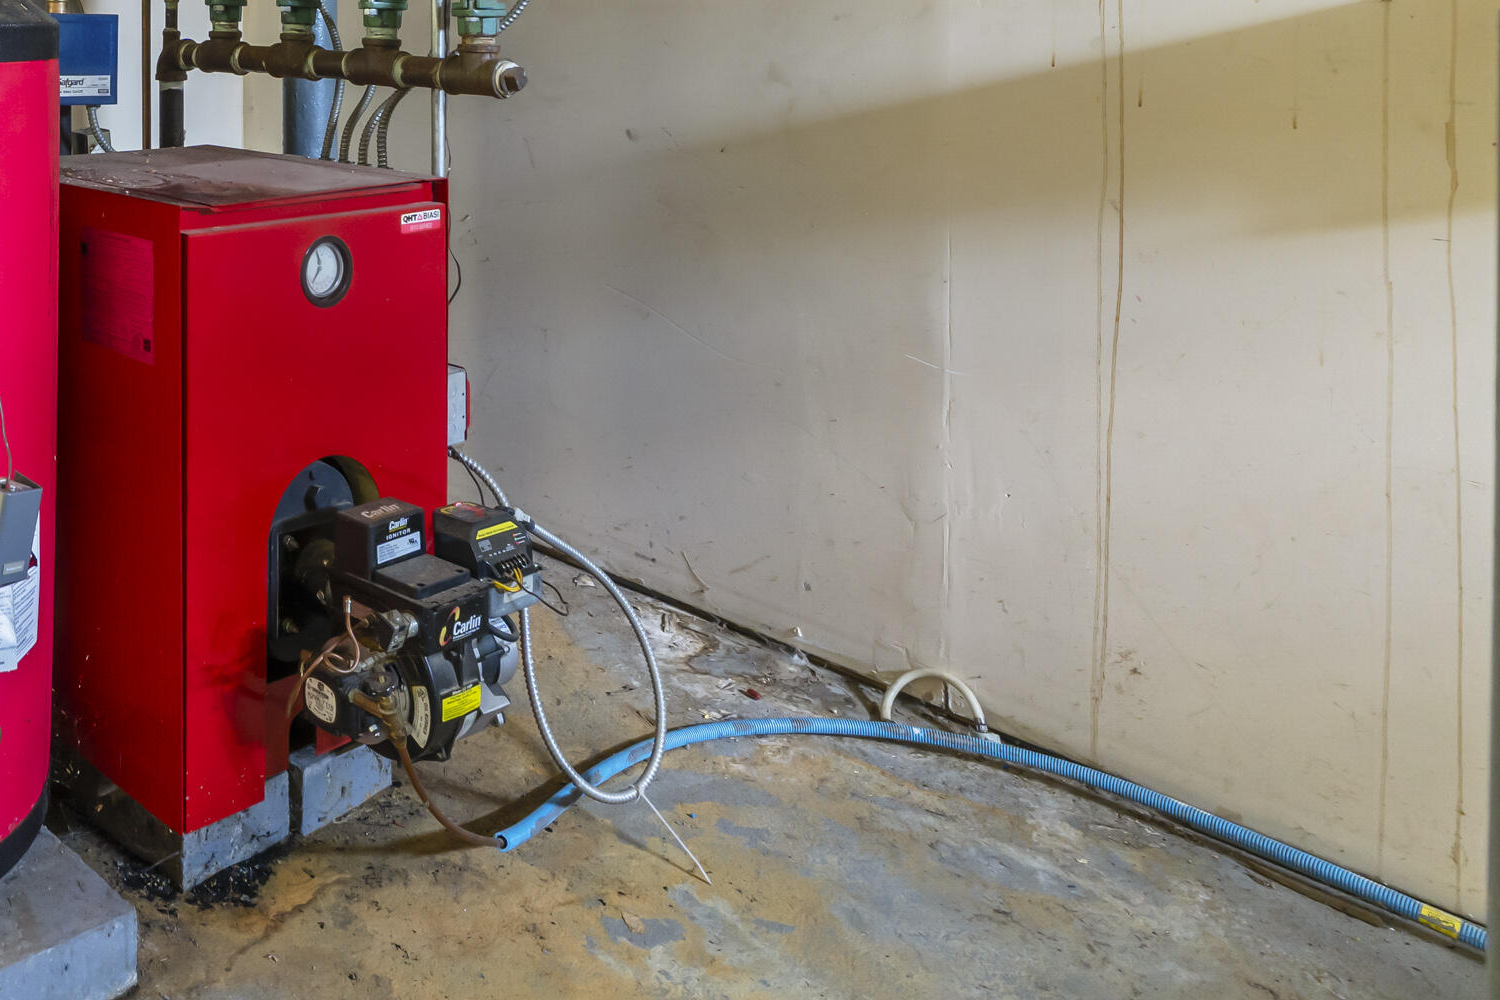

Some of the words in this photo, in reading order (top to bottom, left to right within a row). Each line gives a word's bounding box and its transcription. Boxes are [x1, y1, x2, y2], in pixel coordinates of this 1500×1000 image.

[361, 504, 400, 518] Carlin
[389, 517, 408, 531] Carlin
[452, 614, 481, 636] Carlin
